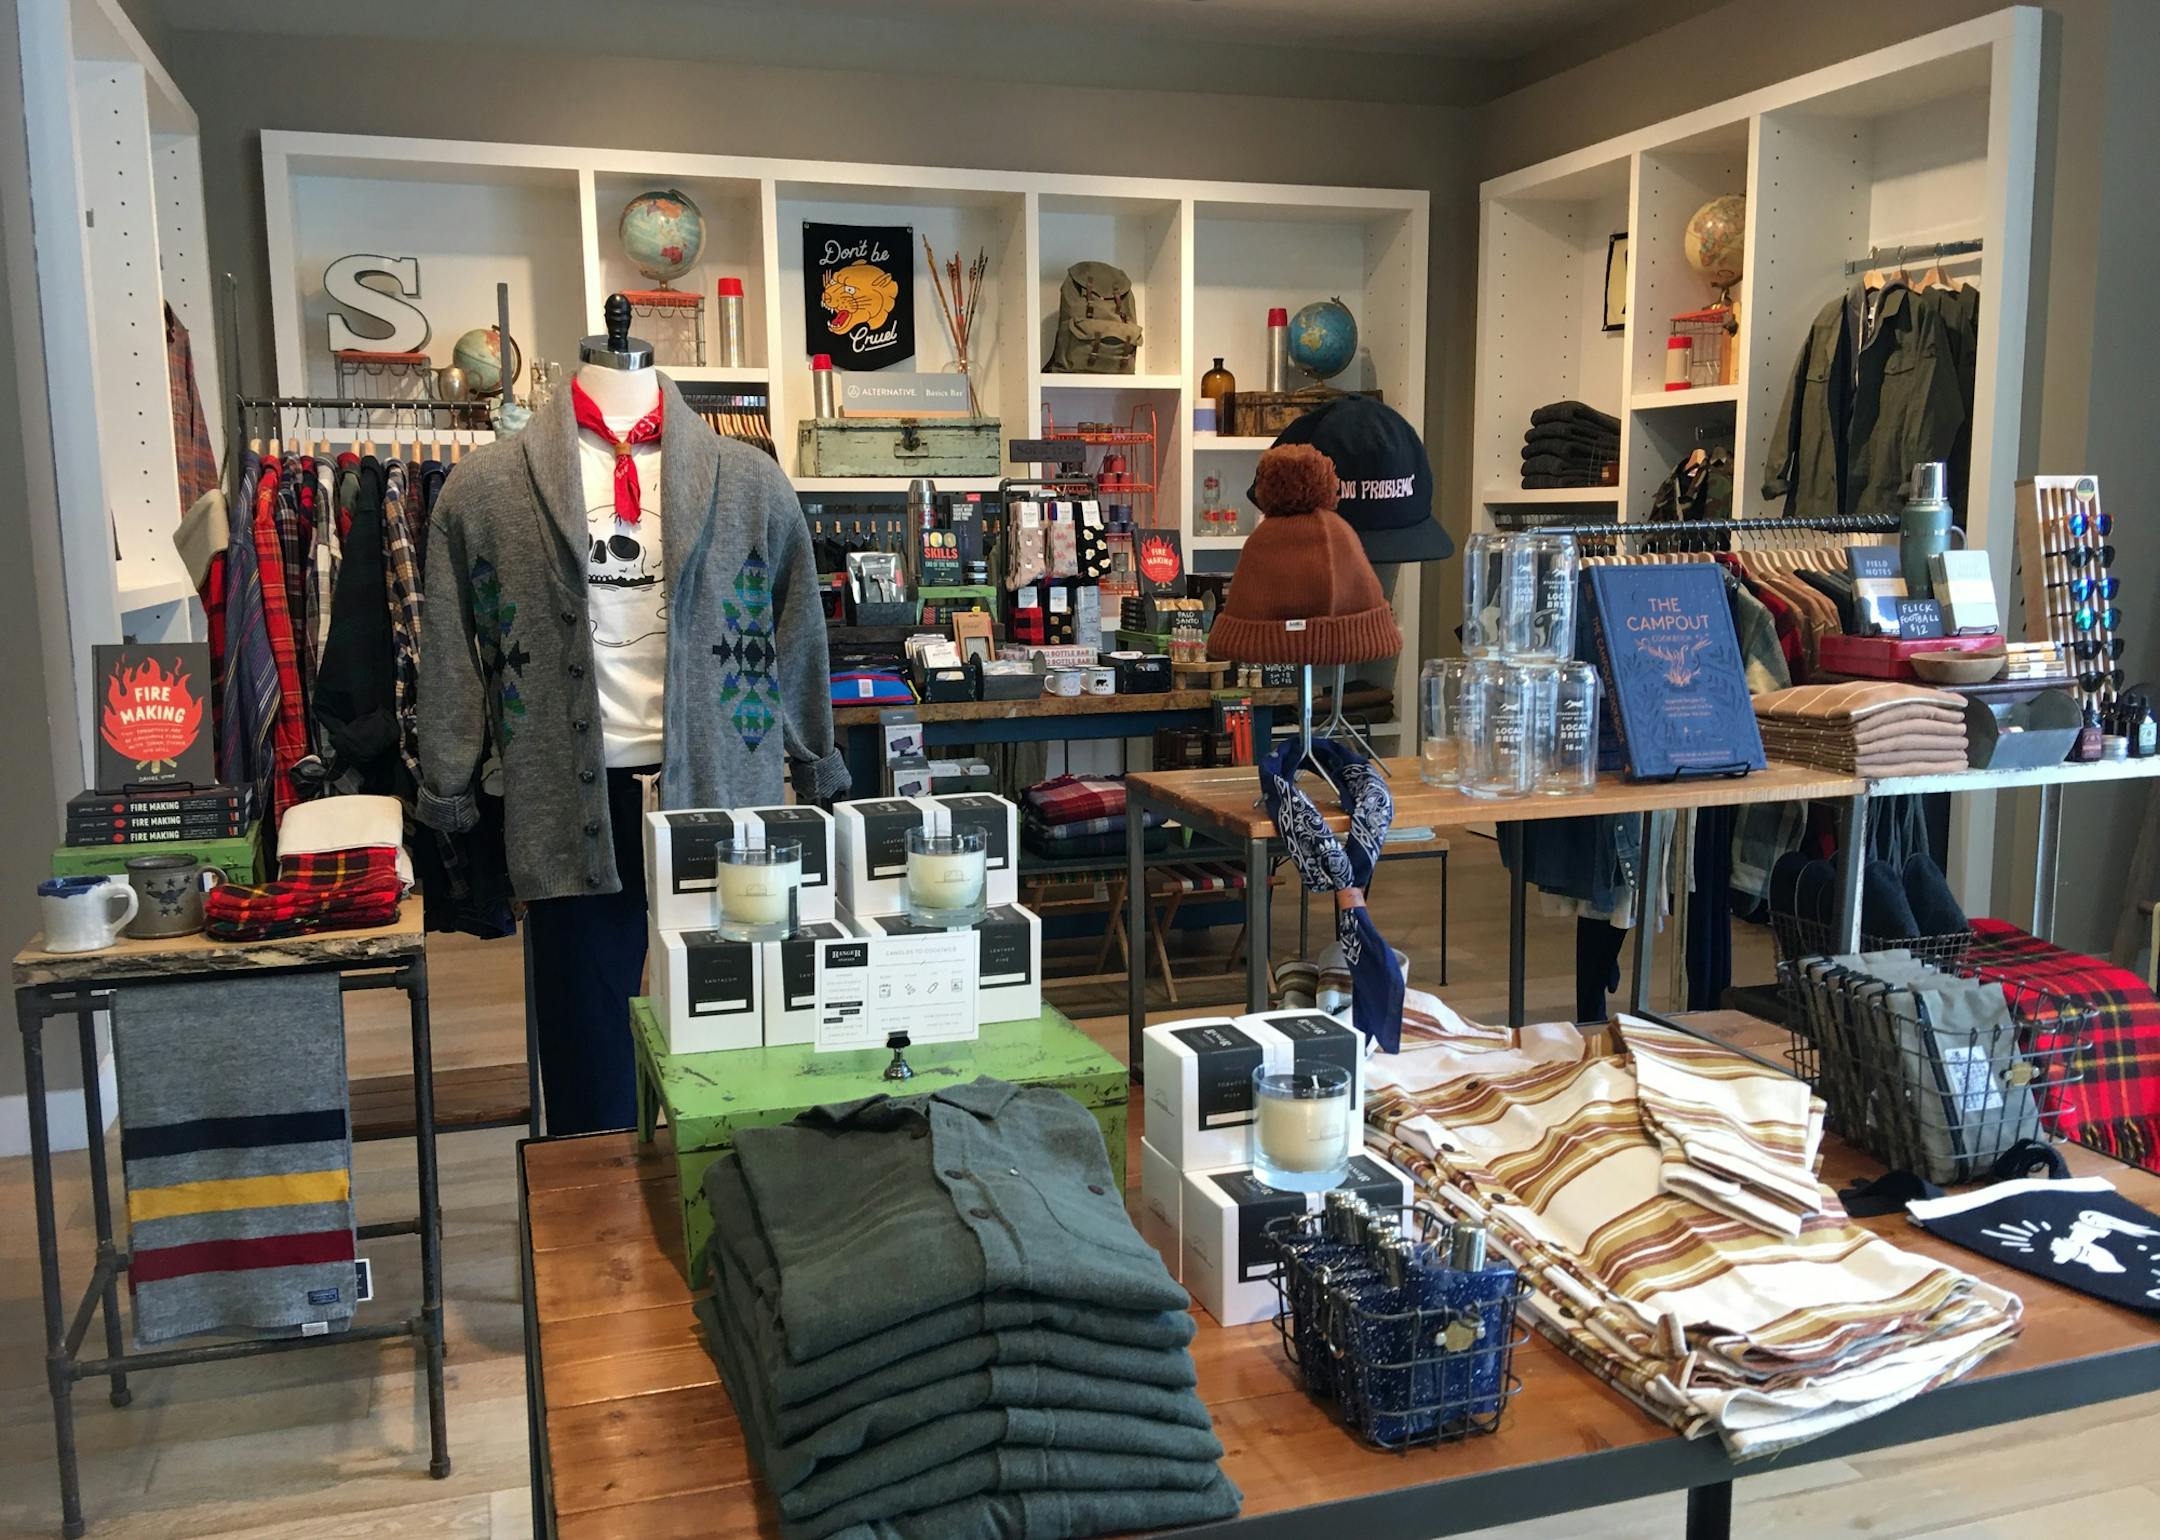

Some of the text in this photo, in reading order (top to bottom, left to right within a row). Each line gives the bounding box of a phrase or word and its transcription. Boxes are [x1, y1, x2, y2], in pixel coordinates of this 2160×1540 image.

[819, 239, 890, 265] Don't be
[324, 253, 429, 353] S
[849, 320, 898, 352] Cruel
[950, 389, 963, 397] Bar
[924, 547, 958, 559] SKILLS
[1151, 548, 1168, 556] FIRE
[1146, 557, 1174, 567] MAKING
[1866, 568, 1892, 576] NOTES
[1647, 598, 1681, 612] THE
[1902, 603, 1933, 613] FLICK
[1626, 614, 1710, 632] CAMPOUT
[1900, 611, 1940, 624] FOOTBALL
[1910, 624, 1928, 636] $12
[134, 686, 171, 703] FIRE
[120, 705, 185, 724] MAKING
[1496, 727, 1523, 735] LOCAL
[1560, 723, 1588, 731] LOCAL
[1560, 731, 1587, 739] BREW
[130, 804, 148, 812] FIRE
[149, 801, 180, 811] MAKING
[131, 818, 150, 827] FIRE
[151, 816, 181, 826] MAKING
[130, 833, 148, 841] FIRE
[149, 830, 180, 840] MAKING
[832, 949, 861, 959] RANGER
[1217, 1079, 1247, 1088] TOBACCO
[1223, 1091, 1241, 1099] MUSK
